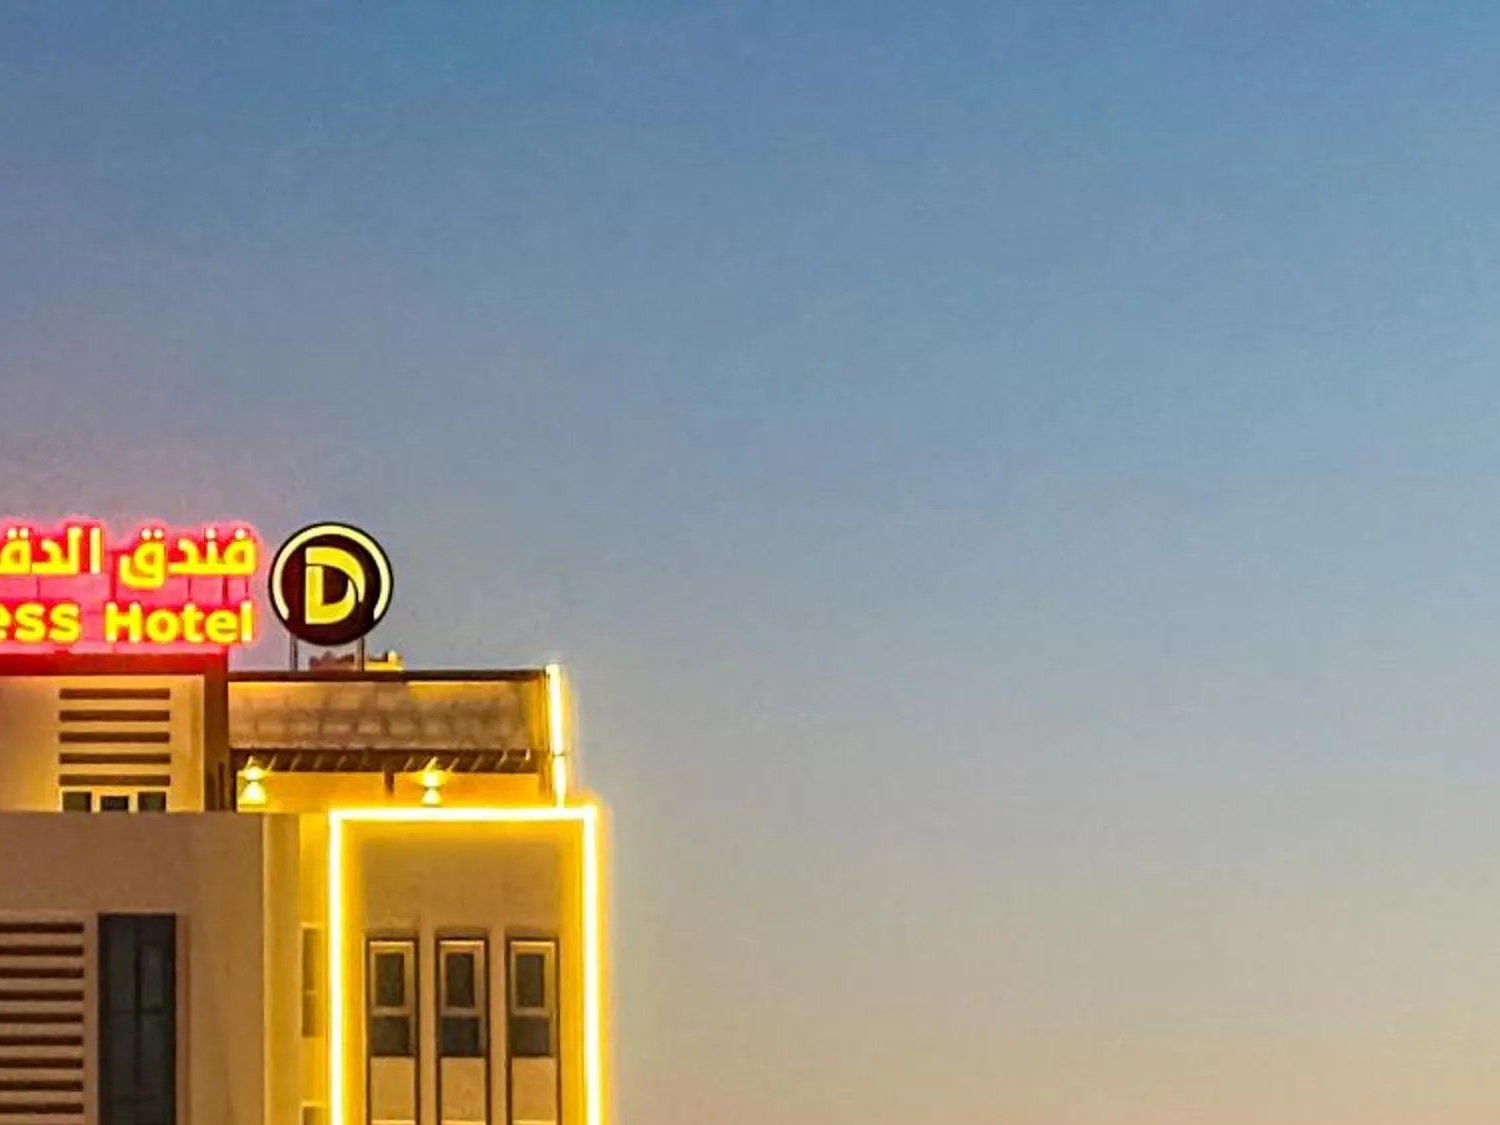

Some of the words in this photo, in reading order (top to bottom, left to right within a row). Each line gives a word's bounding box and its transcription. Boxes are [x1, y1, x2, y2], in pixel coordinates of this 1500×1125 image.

[119, 527, 257, 589] فندق
[305, 546, 366, 625] D
[105, 601, 254, 644] Hotel
